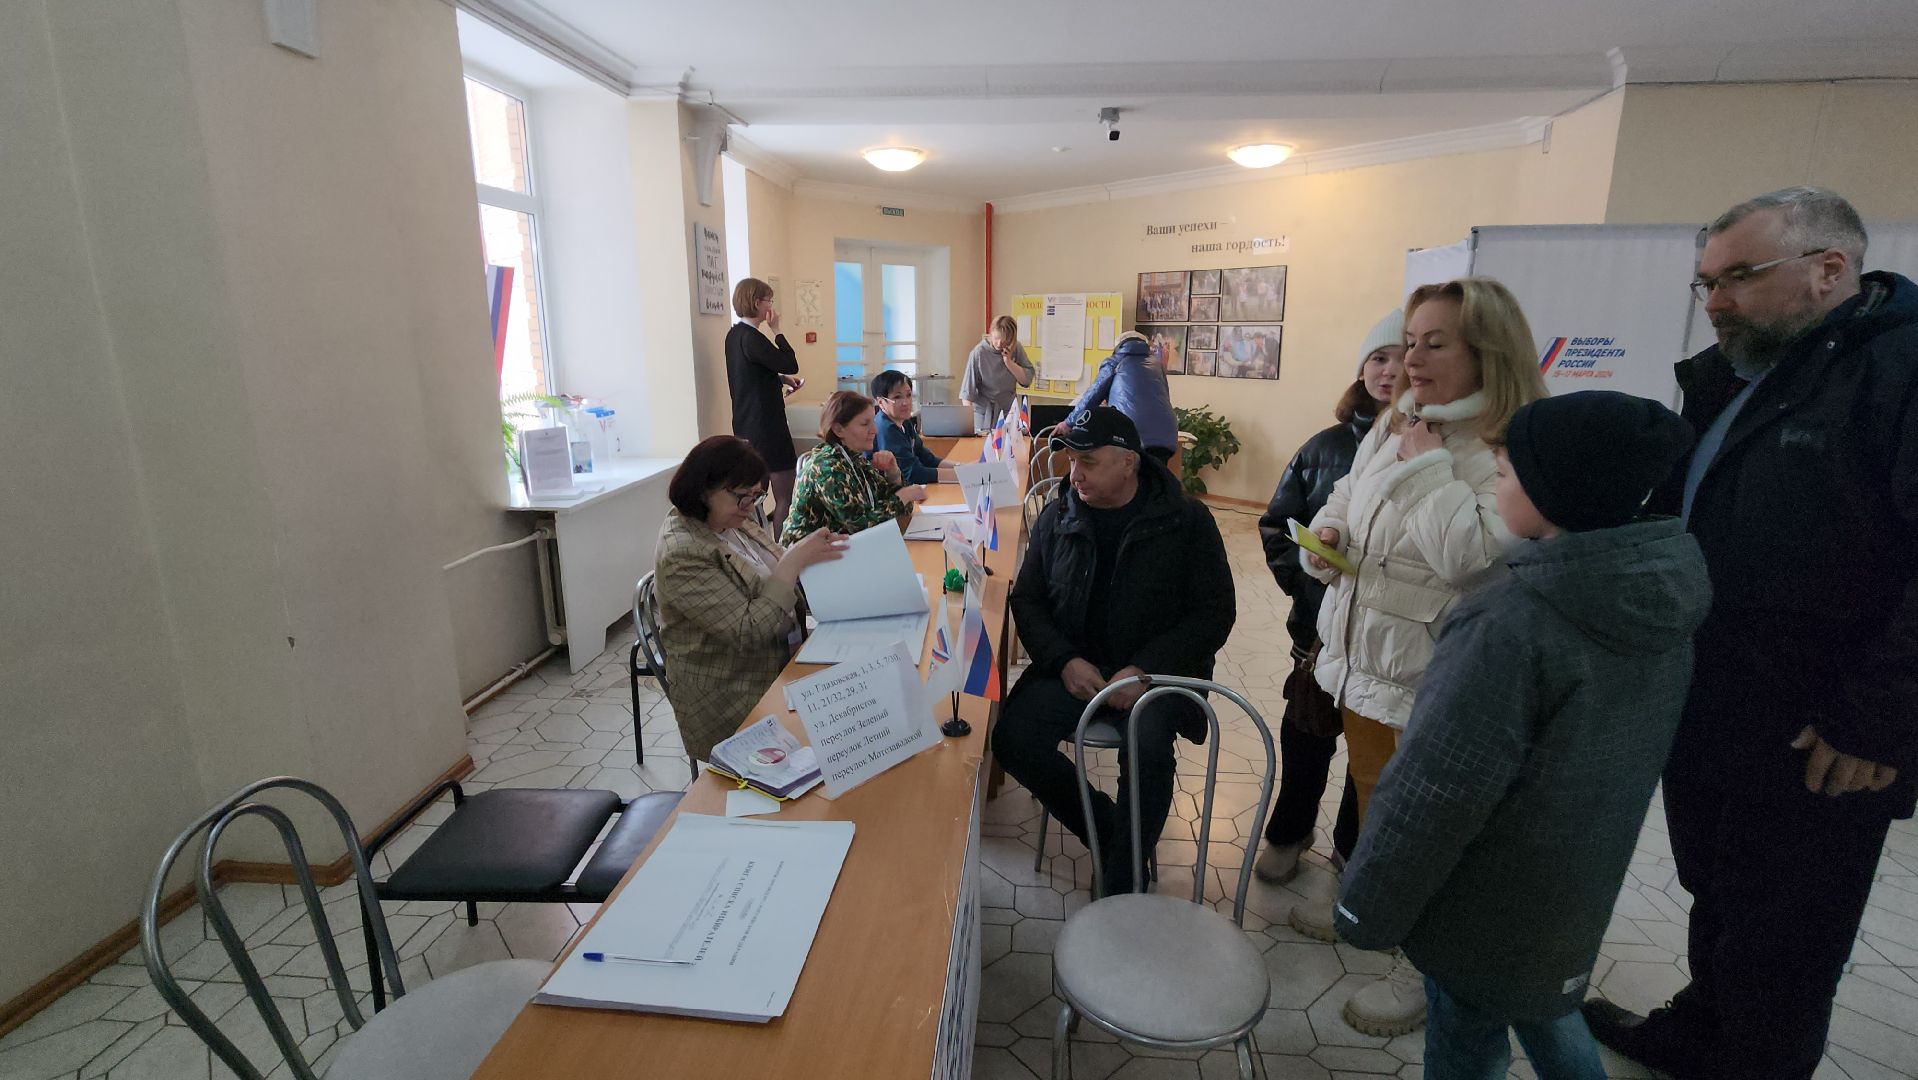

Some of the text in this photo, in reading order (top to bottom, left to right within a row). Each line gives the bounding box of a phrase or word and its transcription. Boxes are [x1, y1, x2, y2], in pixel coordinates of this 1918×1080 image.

[1146, 225, 1176, 236] Ваши
[1178, 221, 1217, 236] успехи
[1191, 235, 1286, 253] наша гордость!
[1570, 337, 1615, 346] ВЫБОРЫ
[1558, 360, 1597, 368] РОССИИ
[1565, 349, 1626, 358] ПРЕЗИДЕНТА
[801, 690, 815, 701] ул.
[807, 703, 820, 713] 11,
[820, 691, 846, 708] 21/32,
[814, 698, 877, 733] ул. Декабристов
[820, 708, 889, 747] переулок Зеленый
[827, 726, 891, 764] переулок Летний
[832, 728, 923, 782] переулок Мотозаводской
[739, 860, 756, 881] КНИГА
[724, 882, 744, 909] СПИСКА
[694, 910, 728, 961] ИЗБИРАТЕЛЕЙ
